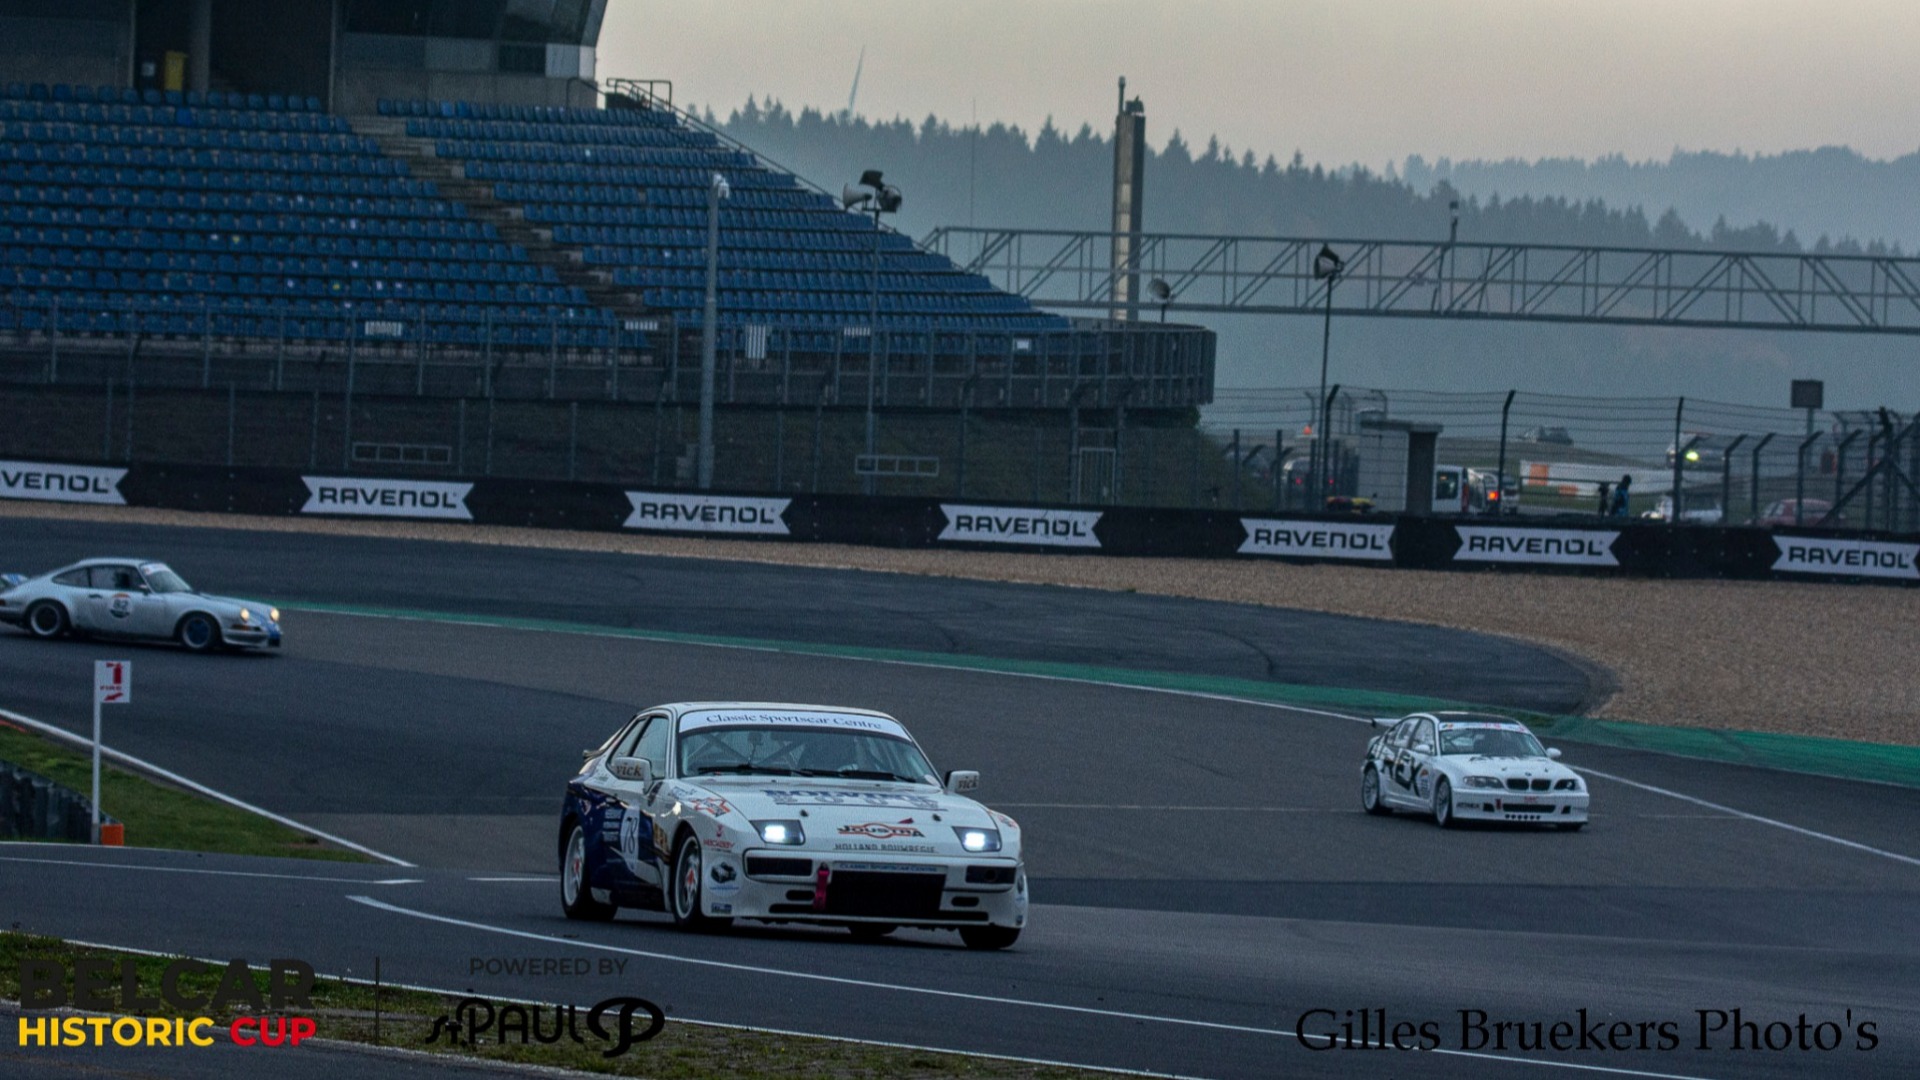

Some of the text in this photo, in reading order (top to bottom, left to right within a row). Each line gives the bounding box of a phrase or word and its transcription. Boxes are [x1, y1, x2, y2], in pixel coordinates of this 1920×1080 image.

[1, 470, 108, 493] VENOL
[319, 487, 457, 509] RAVENOL
[640, 502, 775, 525] RAVENOL
[956, 514, 1087, 538] RAVENOL
[1254, 528, 1384, 551] RAVENOL
[1469, 535, 1604, 556] RAVENOL
[1788, 546, 1909, 569] RAVENOL
[706, 712, 882, 729] Classic Sportscar Centre
[616, 763, 642, 777] vick
[623, 816, 638, 855] 78
[835, 843, 878, 851] HOLLAND
